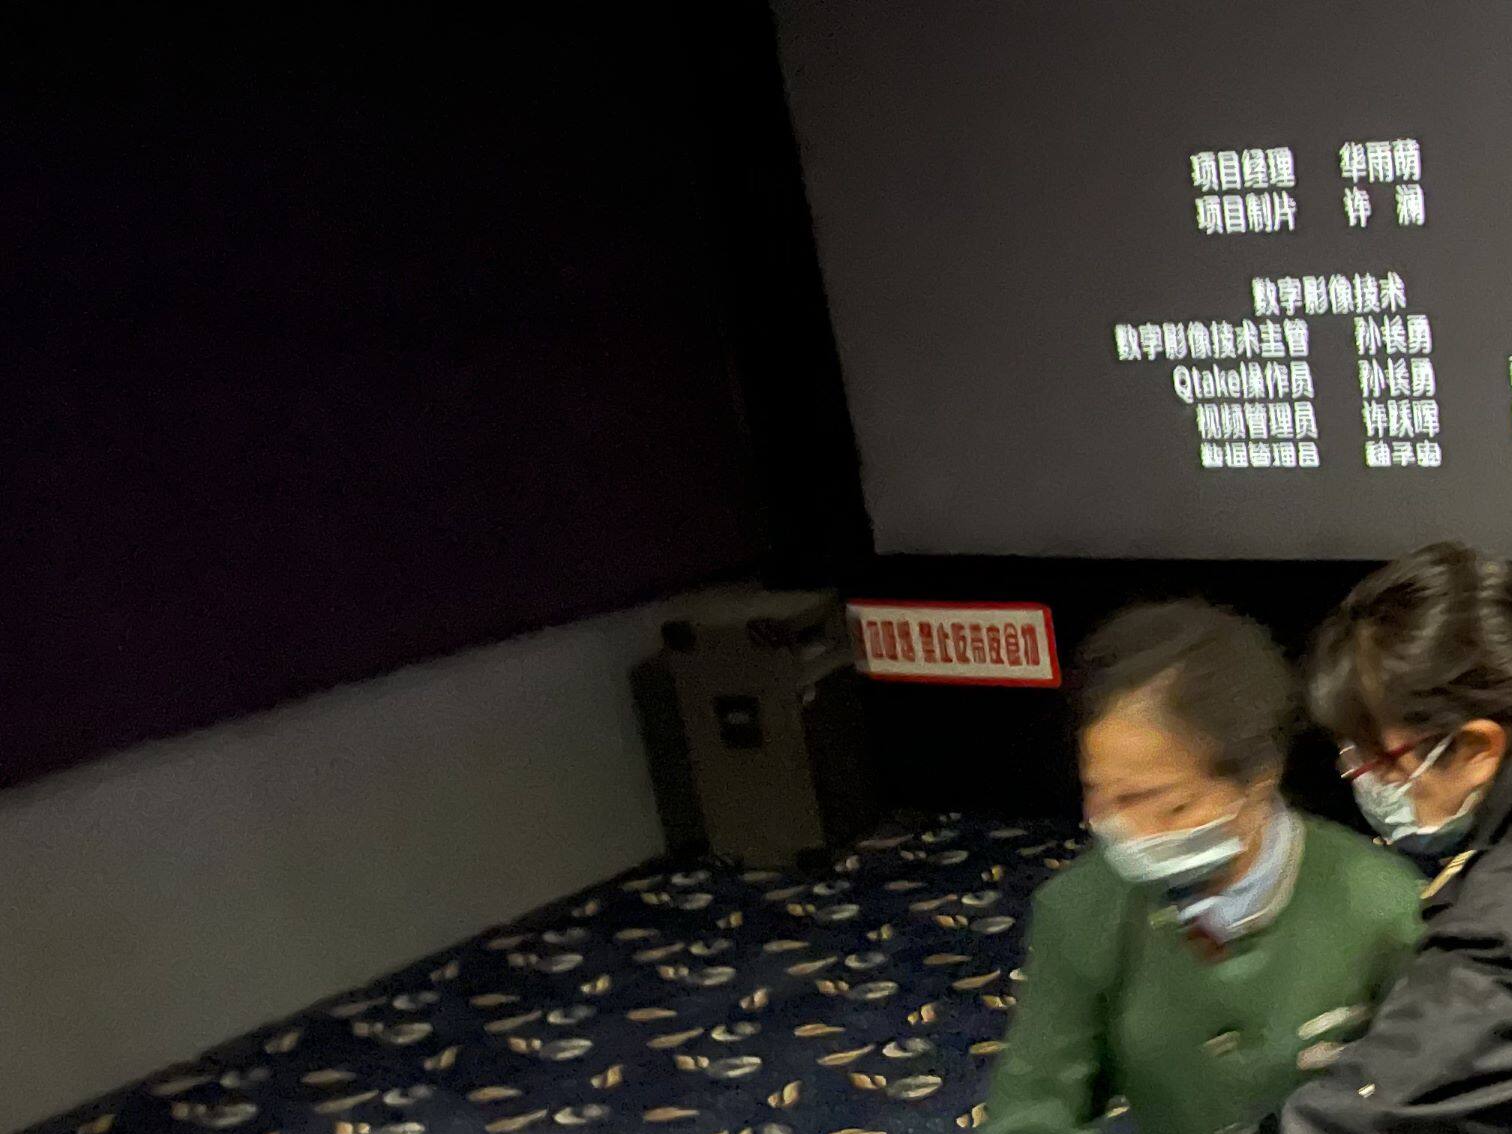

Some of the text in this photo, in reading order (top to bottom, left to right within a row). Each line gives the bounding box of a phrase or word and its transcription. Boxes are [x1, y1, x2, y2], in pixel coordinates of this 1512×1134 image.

[1189, 146, 1296, 193] 项目经理
[1194, 190, 1297, 235] 项目制片
[1251, 271, 1407, 317] 数字影像技术
[1114, 318, 1309, 361] 数字影像技术主管
[1195, 402, 1319, 440] 视频管理员
